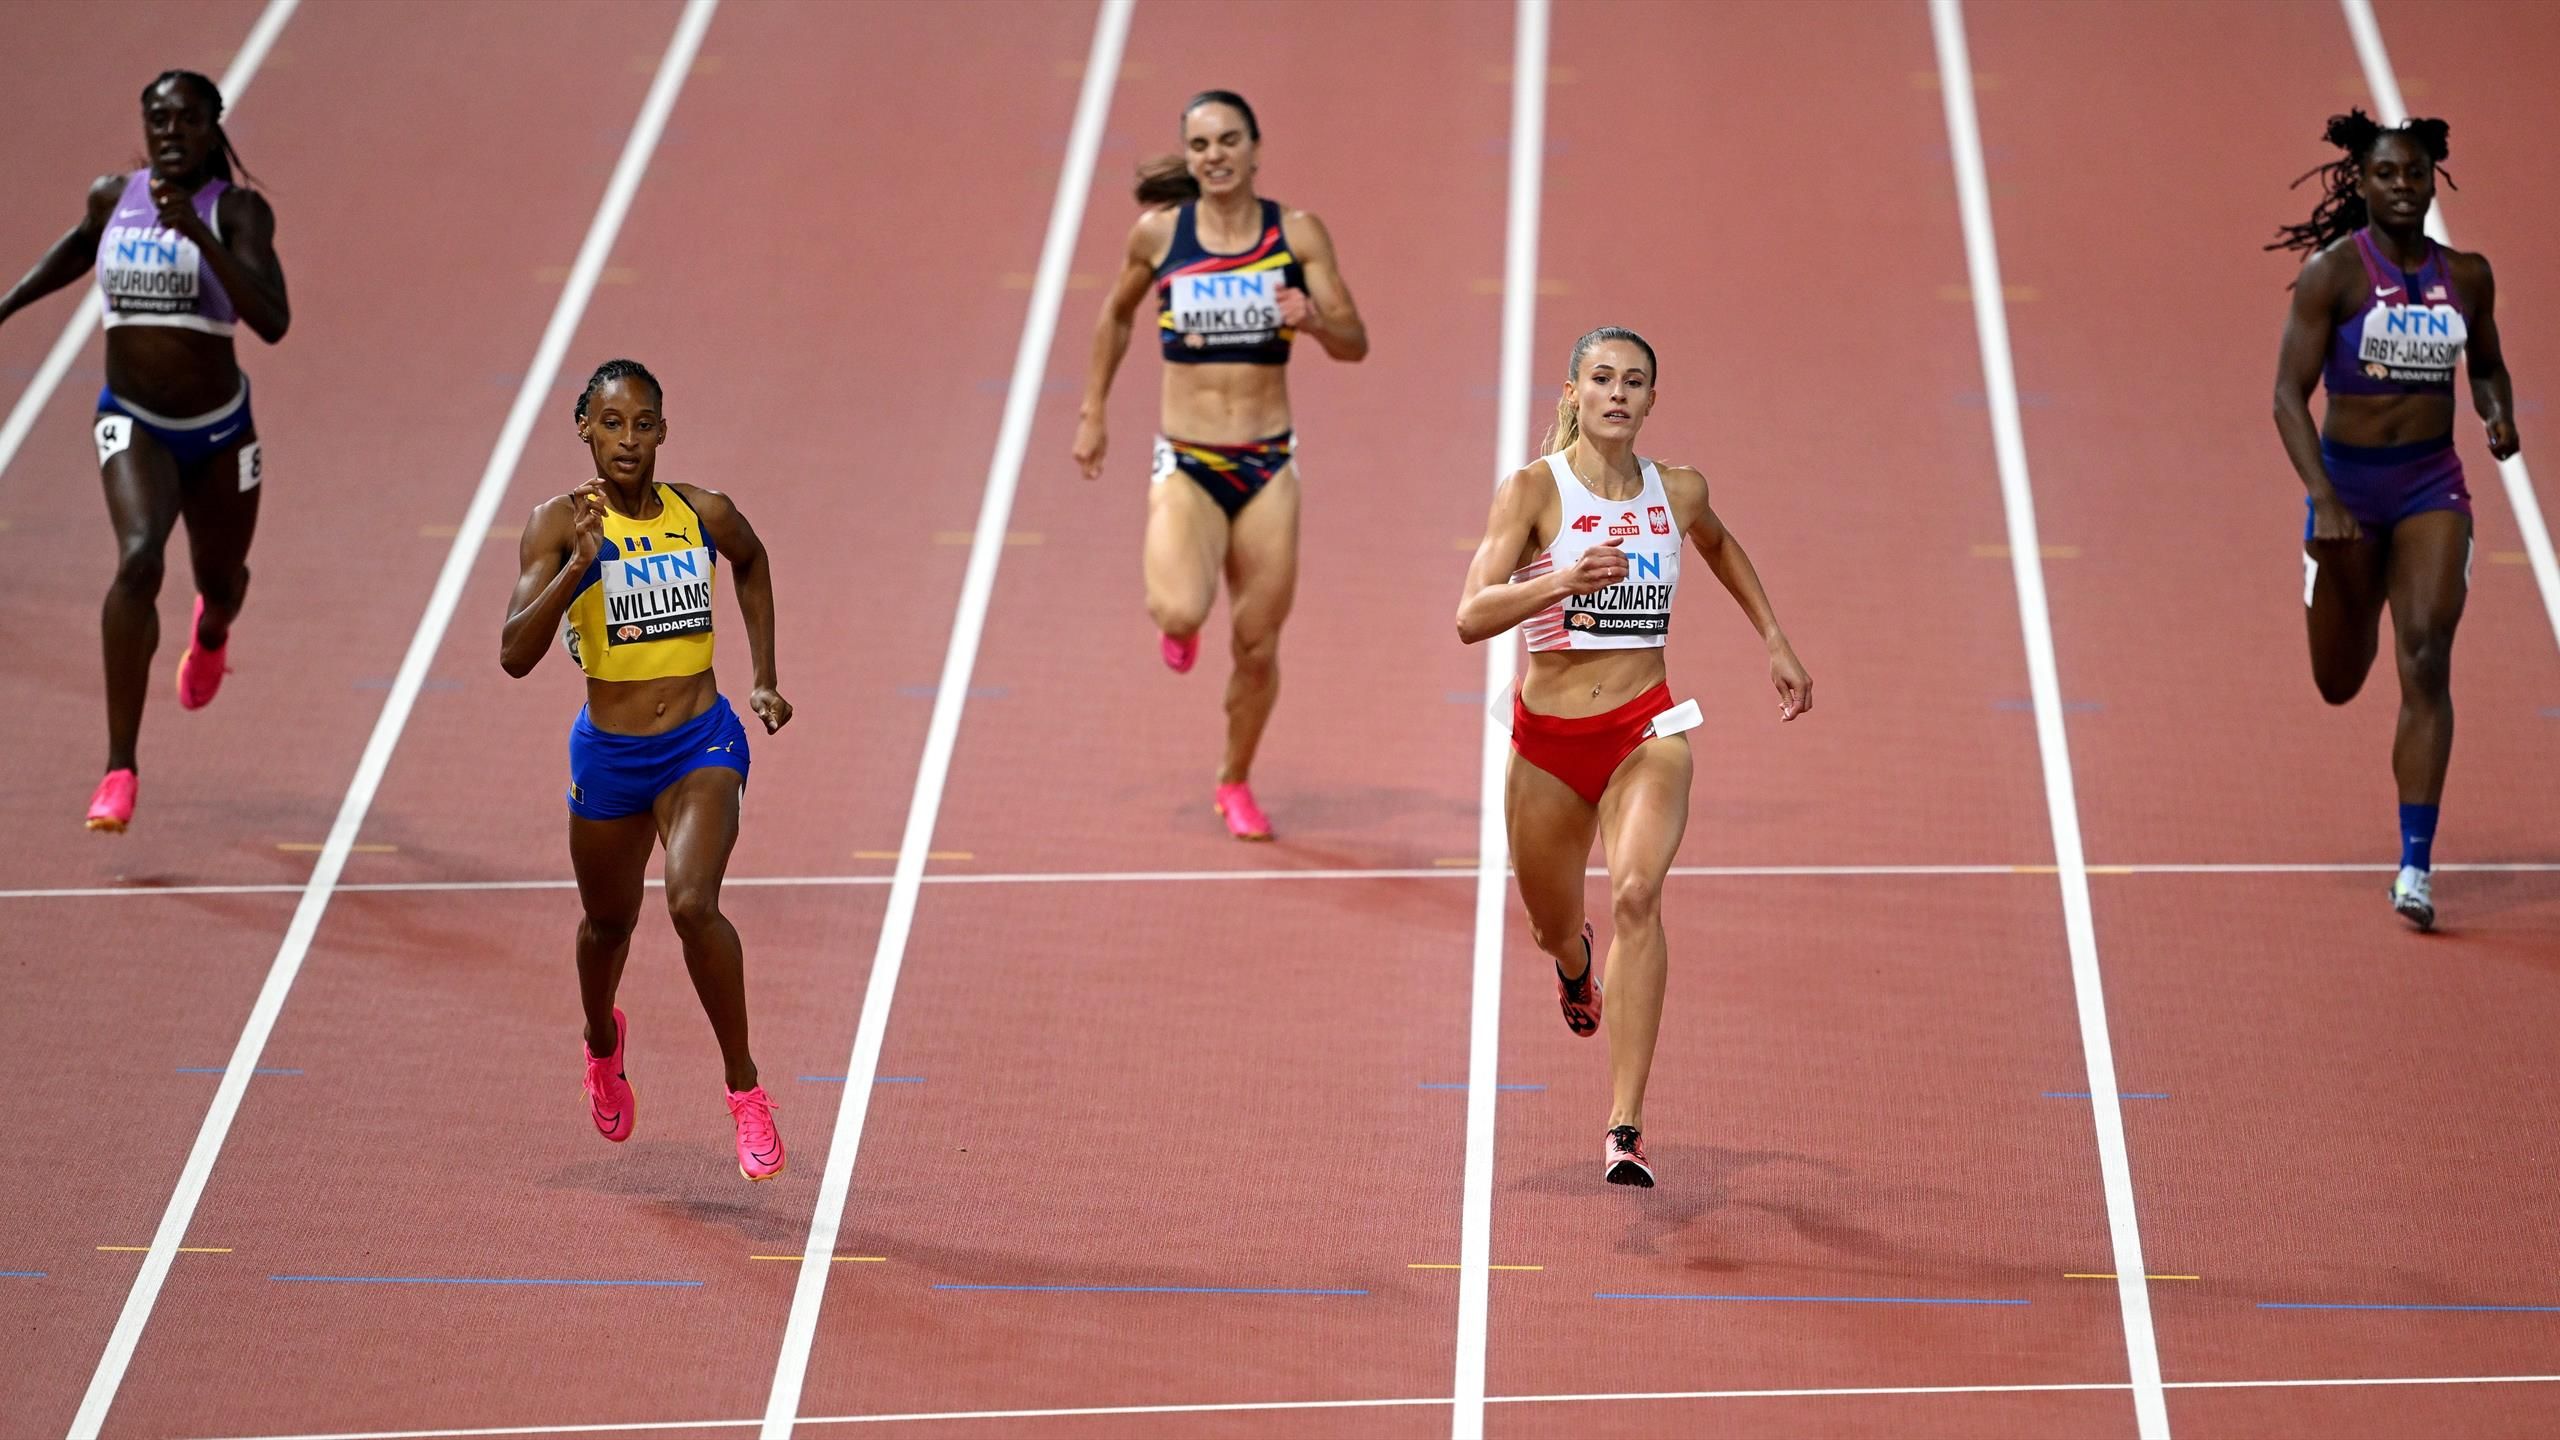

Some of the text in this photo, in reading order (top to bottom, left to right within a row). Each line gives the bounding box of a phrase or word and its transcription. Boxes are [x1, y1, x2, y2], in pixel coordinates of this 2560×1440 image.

[117, 241, 177, 264] NTN
[1193, 275, 1263, 299] NTN
[1182, 304, 1275, 329] MIKLÓS
[2386, 311, 2448, 336] NTN
[1571, 515, 1602, 533] 4F
[1610, 526, 1638, 535] ORLEN
[624, 551, 697, 588] NTN
[609, 582, 710, 622] WILLIAMS
[645, 617, 704, 635] BUDAPEST
[1599, 619, 1657, 629] BUDAPEST
